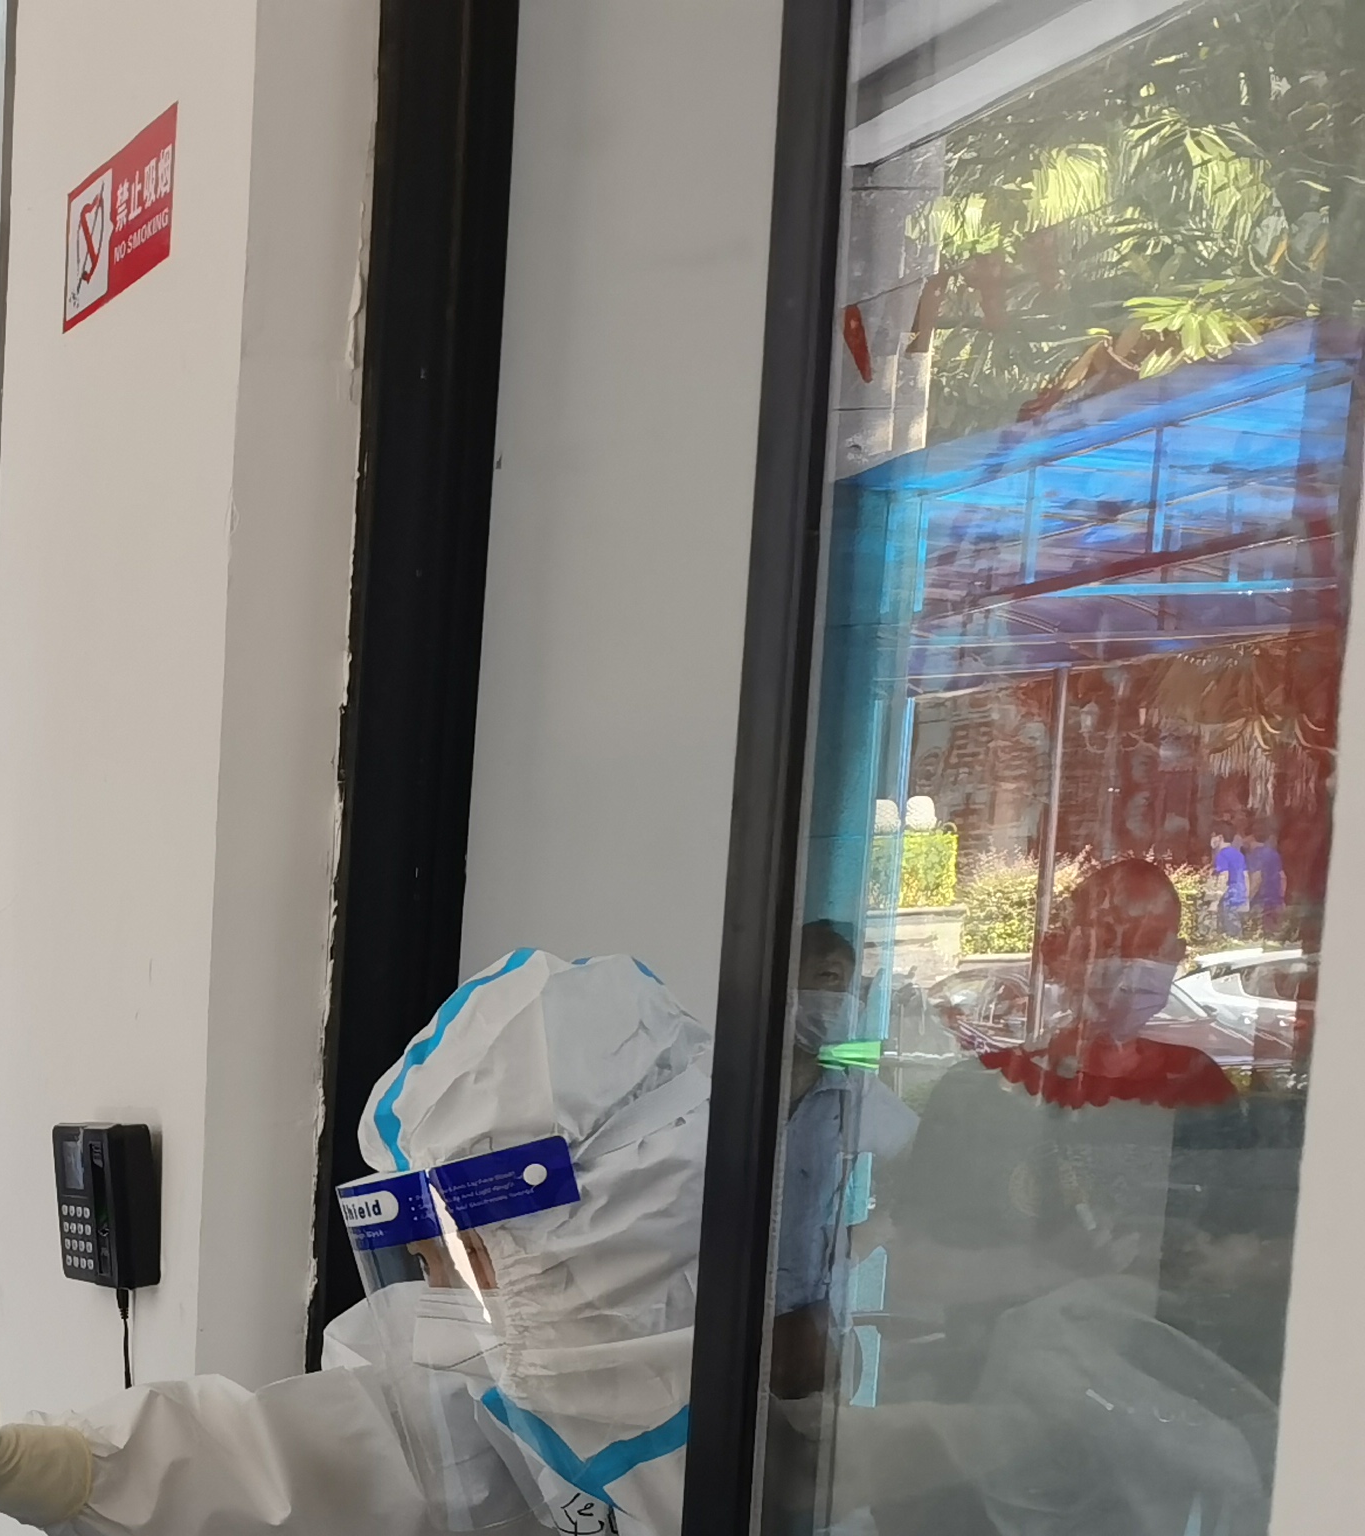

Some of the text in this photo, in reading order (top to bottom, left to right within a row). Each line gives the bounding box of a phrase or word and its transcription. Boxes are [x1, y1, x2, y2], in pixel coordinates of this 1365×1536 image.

[115, 143, 172, 232] 禁止吸烟
[113, 206, 169, 265] NO SMOKING
